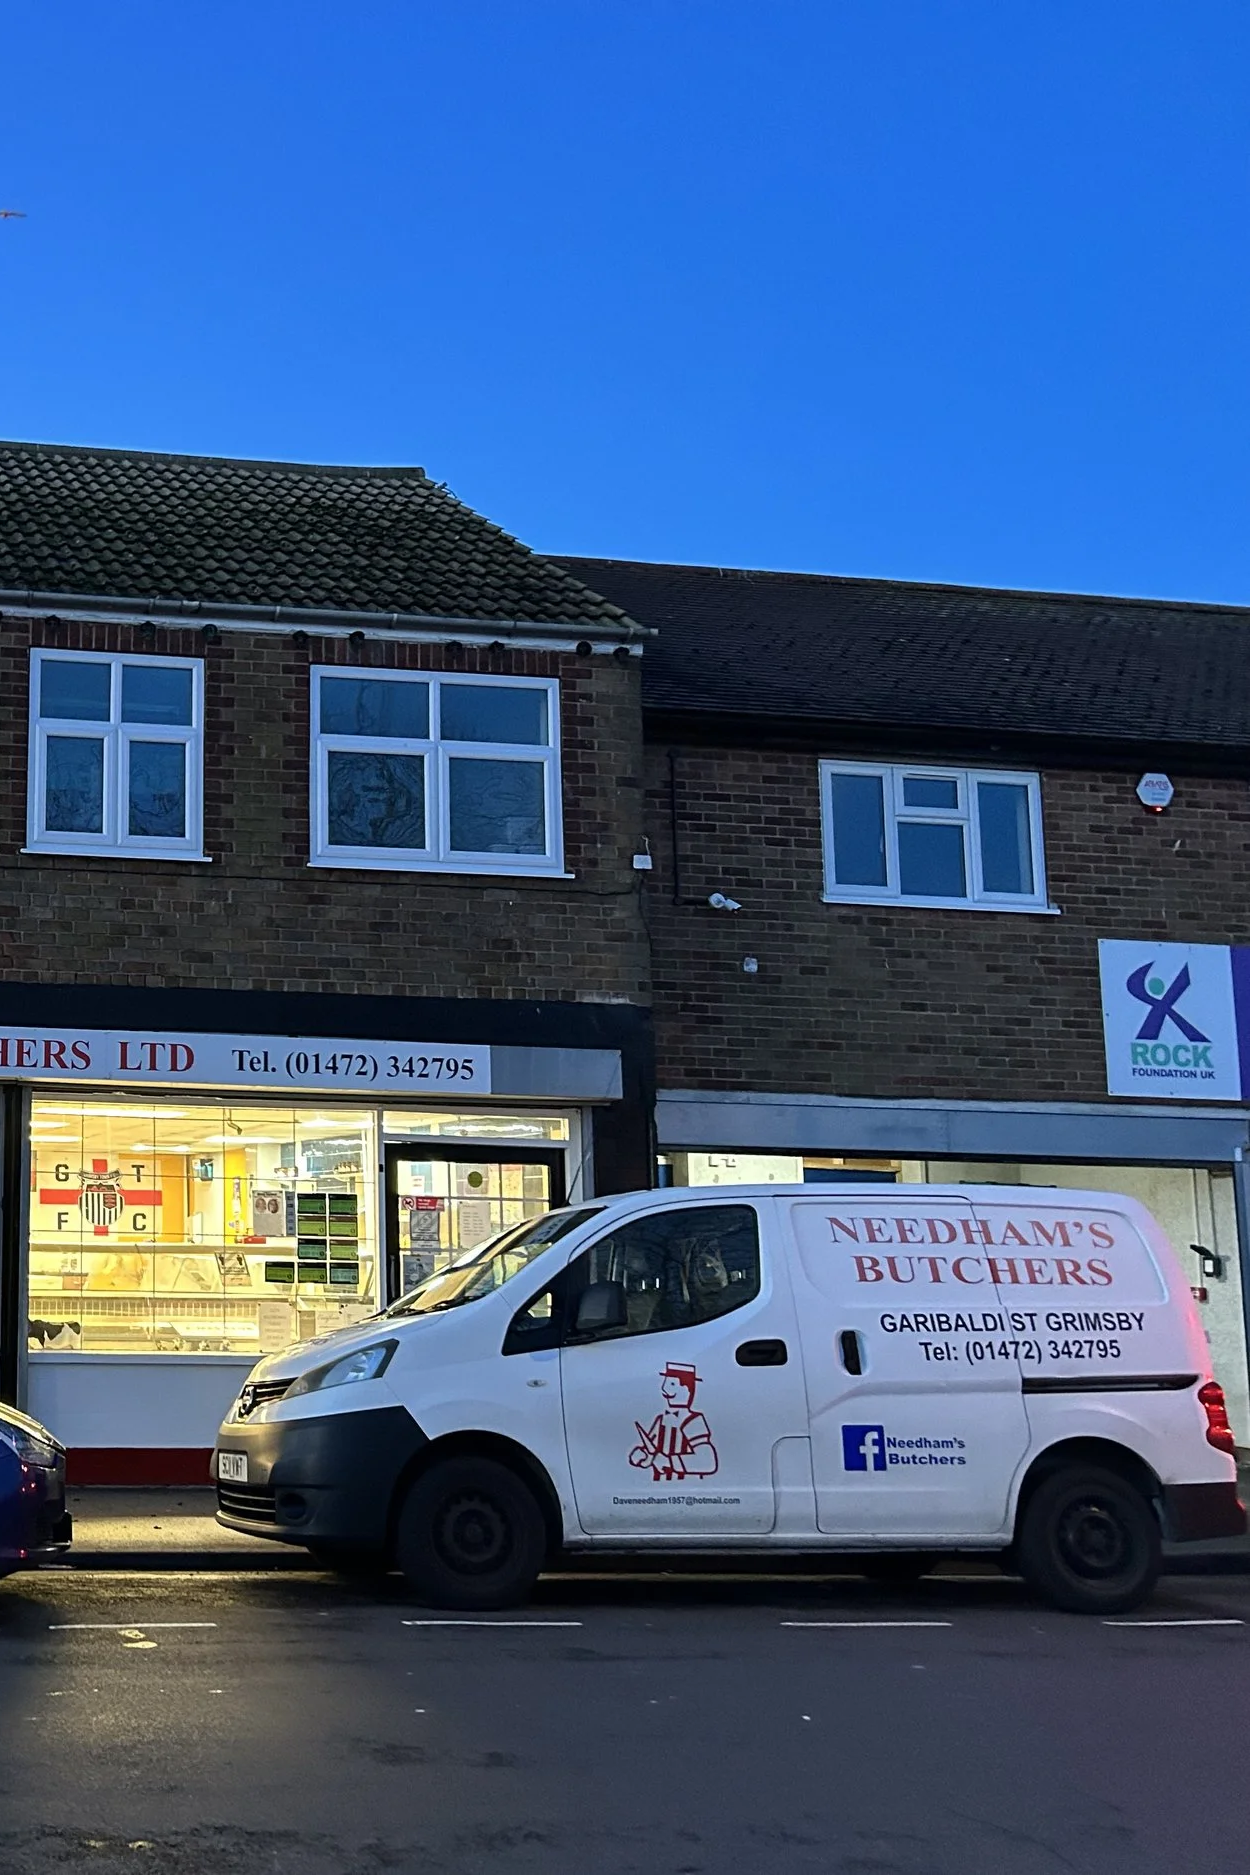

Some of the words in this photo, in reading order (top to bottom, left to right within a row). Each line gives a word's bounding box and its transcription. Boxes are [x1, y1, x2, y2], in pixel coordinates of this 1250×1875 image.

[118, 1040, 195, 1072] LTD
[231, 1049, 277, 1073] Tel.
[285, 1051, 379, 1082] (01472)
[386, 1055, 475, 1080] 342795
[1130, 1043, 1215, 1069] ROCK
[1132, 1067, 1197, 1079] FOUNDATION
[1200, 1070, 1216, 1079] UK
[54, 1163, 69, 1182] G
[131, 1164, 145, 1183] T
[57, 1212, 69, 1230] F
[132, 1213, 147, 1231] C
[825, 1216, 1116, 1249] NEEDHAM'S
[851, 1255, 1113, 1286] BUTCHERS
[880, 1312, 1005, 1333] GARIBALDI
[1011, 1312, 1038, 1332] ST
[1045, 1312, 1146, 1331] GRIMSBY
[918, 1341, 959, 1362] Tel:
[965, 1340, 1043, 1365] (01472)
[1049, 1339, 1121, 1360] 342795
[886, 1436, 966, 1450] Needham's
[888, 1453, 967, 1466] Butchers
